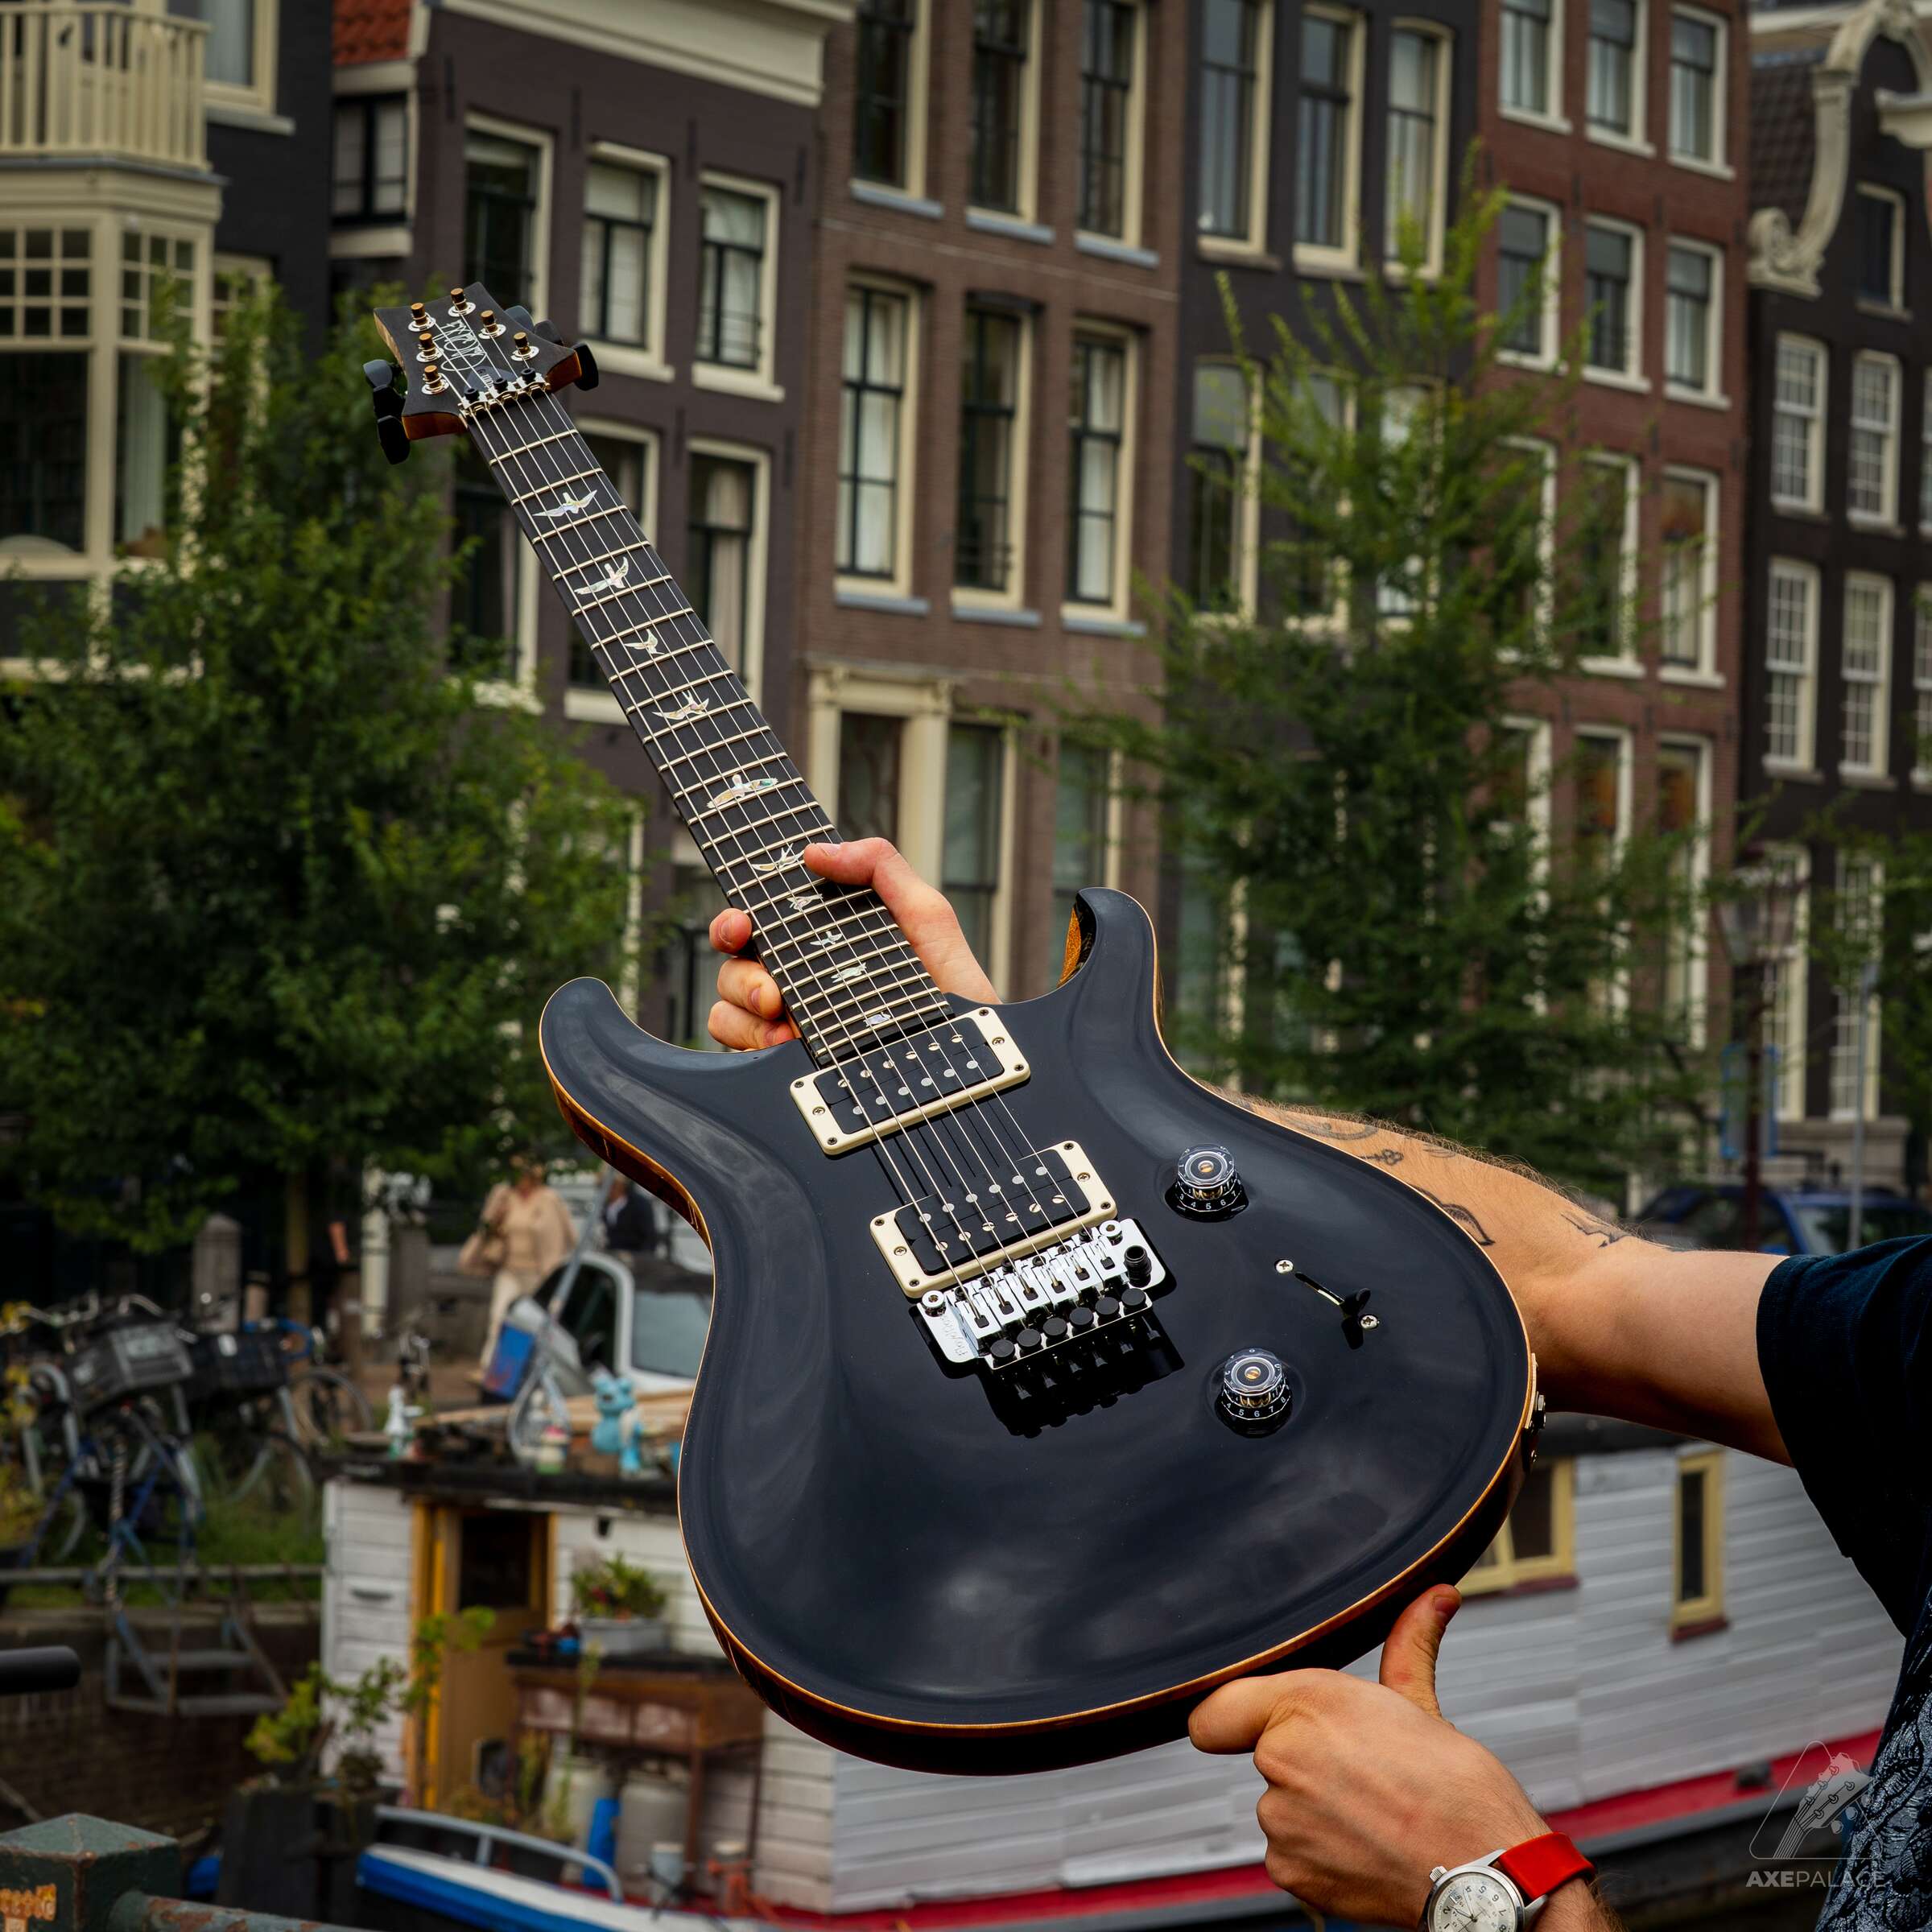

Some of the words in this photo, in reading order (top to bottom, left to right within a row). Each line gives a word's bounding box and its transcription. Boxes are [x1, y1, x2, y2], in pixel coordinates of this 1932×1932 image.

[1479, 1885, 1487, 1893] 5
[1443, 1905, 1451, 1914] 2
[1499, 1924, 1507, 1932] 8
